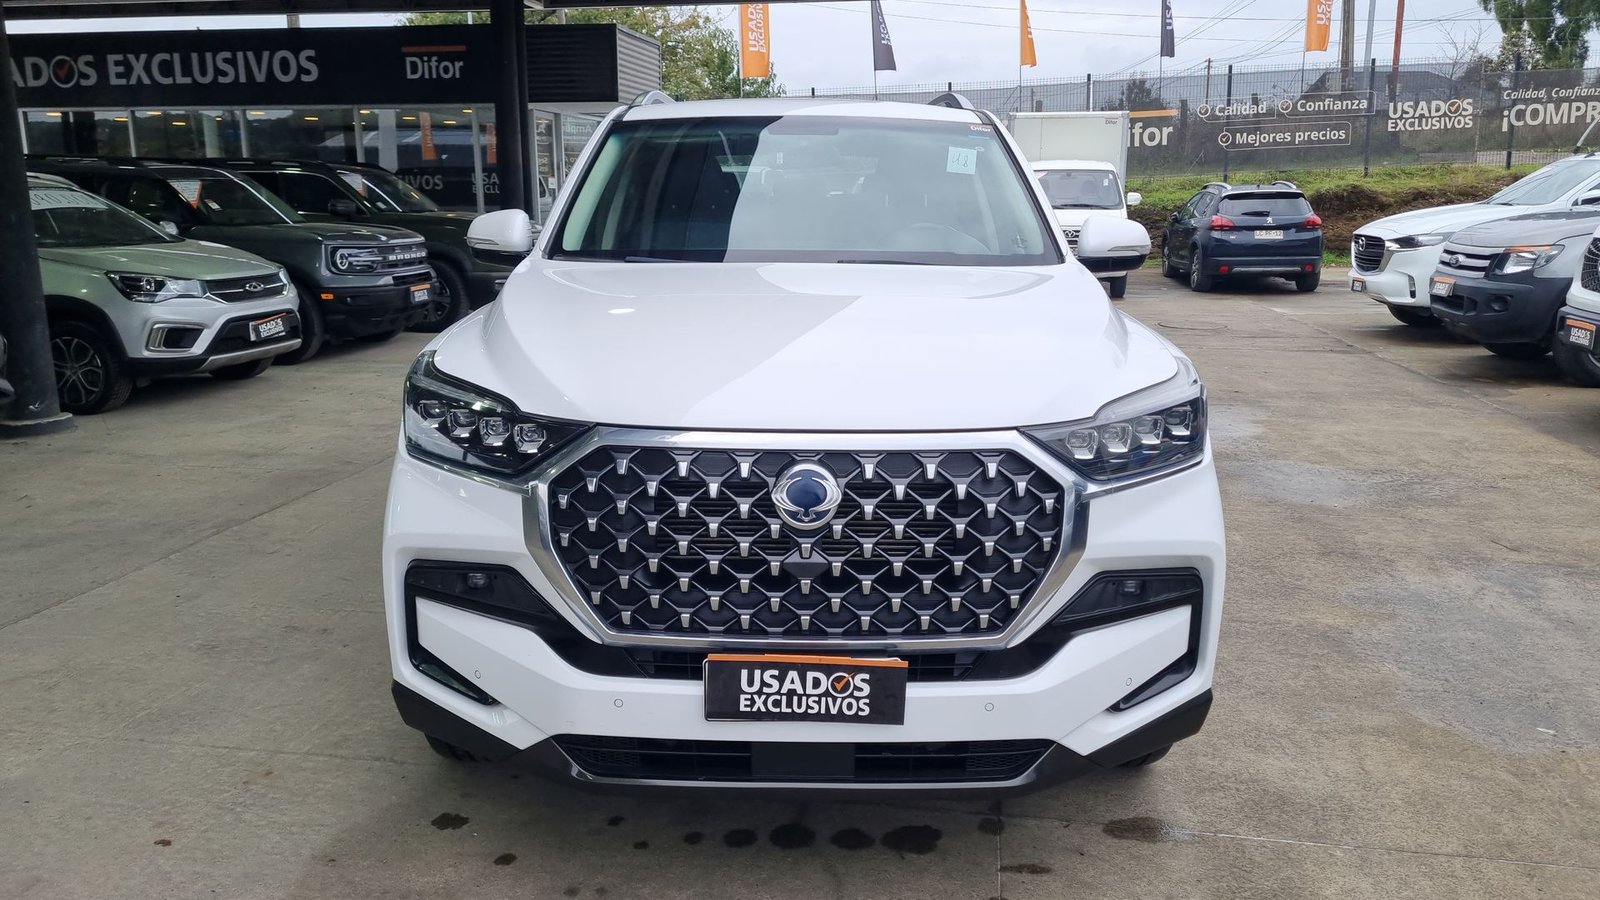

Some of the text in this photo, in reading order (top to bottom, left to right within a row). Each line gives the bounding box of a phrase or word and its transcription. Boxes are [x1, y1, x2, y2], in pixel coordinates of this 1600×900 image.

[106, 49, 319, 86] EXCLUSIVOS
[405, 56, 464, 80] Difor
[1215, 102, 1267, 116] Calidad
[1297, 98, 1368, 112] Confianza
[1388, 98, 1473, 119] USADOS
[1388, 115, 1473, 132] EXCLUSIVOS
[1235, 128, 1346, 147] Mejores precios
[389, 252, 426, 261] BRONCO
[740, 669, 871, 698] USADOS
[739, 694, 871, 716] EXCLUSIVOS
